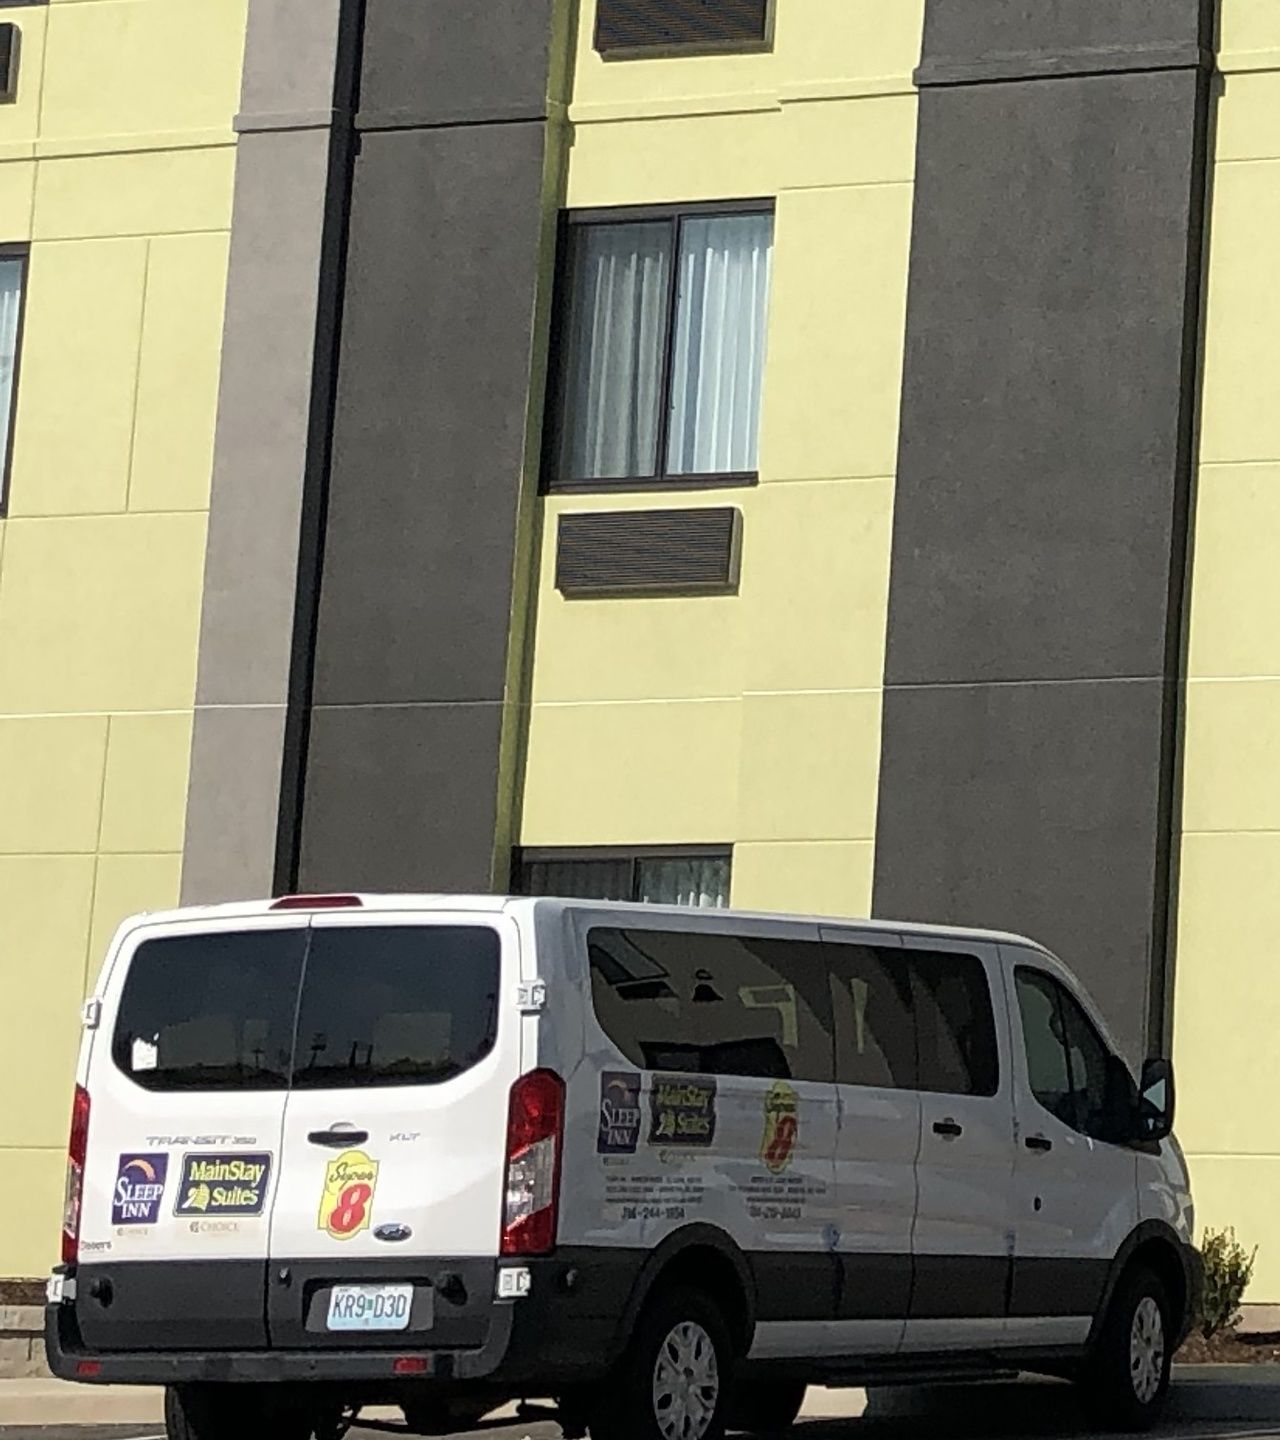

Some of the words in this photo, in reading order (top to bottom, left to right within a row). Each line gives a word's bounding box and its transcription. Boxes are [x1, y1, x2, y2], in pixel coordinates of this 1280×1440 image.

[145, 1135, 231, 1146] TRANSIT
[188, 1159, 266, 1188] MainStay
[113, 1176, 164, 1206] SLEEP
[211, 1184, 260, 1207] Suites
[121, 1203, 152, 1219] INN
[329, 1183, 372, 1234] 8
